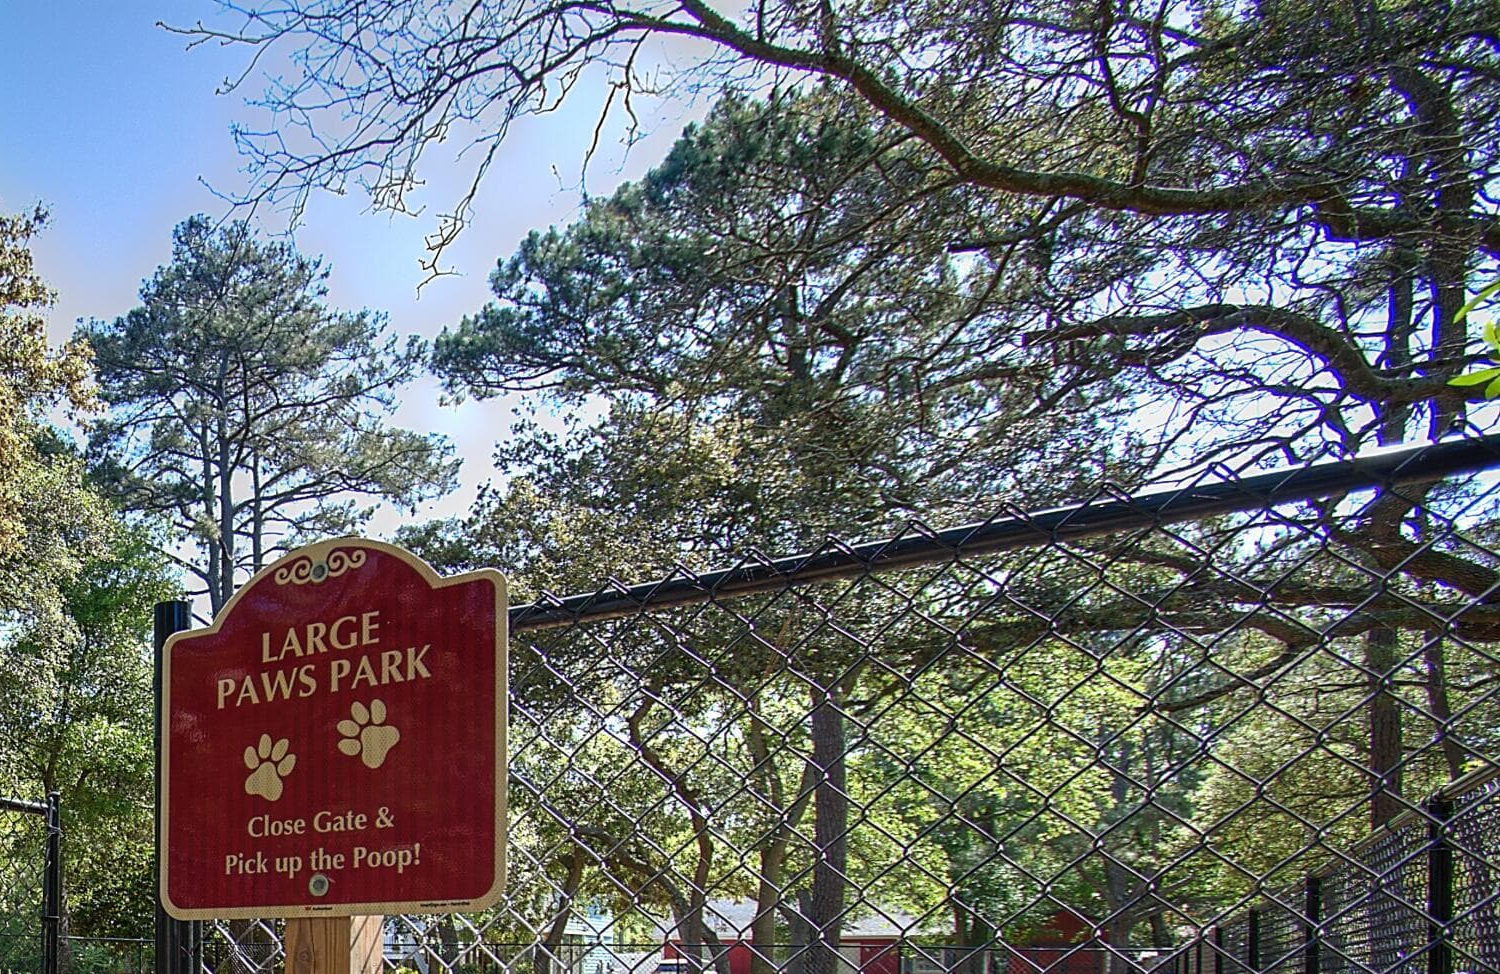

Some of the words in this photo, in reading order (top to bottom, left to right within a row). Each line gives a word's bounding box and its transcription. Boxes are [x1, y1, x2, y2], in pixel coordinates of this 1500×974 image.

[262, 610, 381, 663] LARGE
[217, 665, 316, 710] PAWS
[331, 644, 432, 693] PARK
[247, 813, 306, 838] Close
[313, 809, 367, 832] Gate
[375, 806, 395, 829] &
[225, 852, 268, 876] Pick
[276, 857, 302, 879] up
[310, 848, 345, 871] the
[353, 844, 421, 874] Poop!
